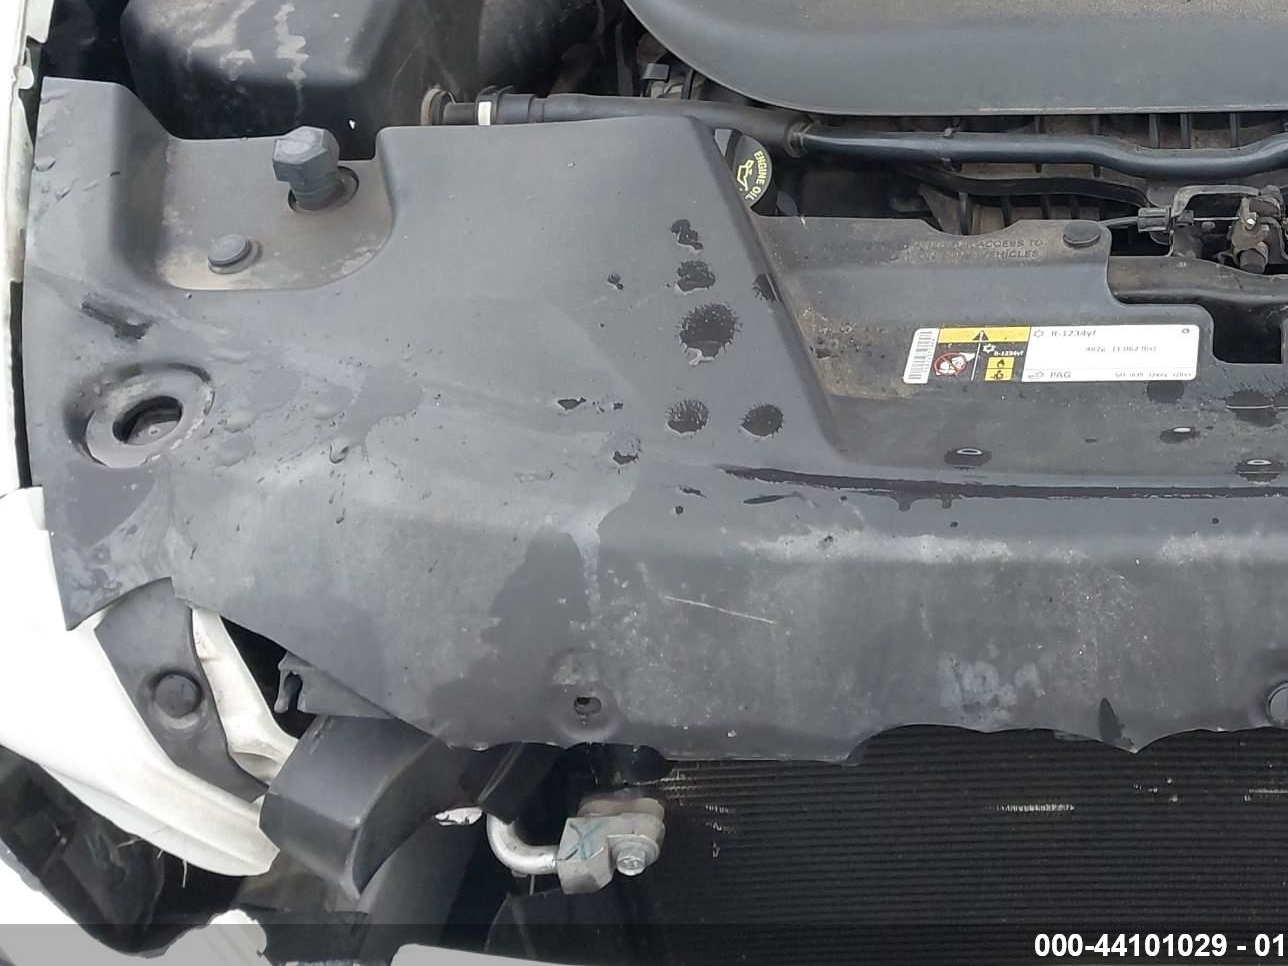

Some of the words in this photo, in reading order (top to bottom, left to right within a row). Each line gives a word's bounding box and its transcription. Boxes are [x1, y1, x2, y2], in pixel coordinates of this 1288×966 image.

[753, 150, 768, 185] ENGINE
[744, 186, 762, 201] OIL
[1051, 329, 1097, 338] R-1234yf
[1050, 371, 1072, 379] PAG
